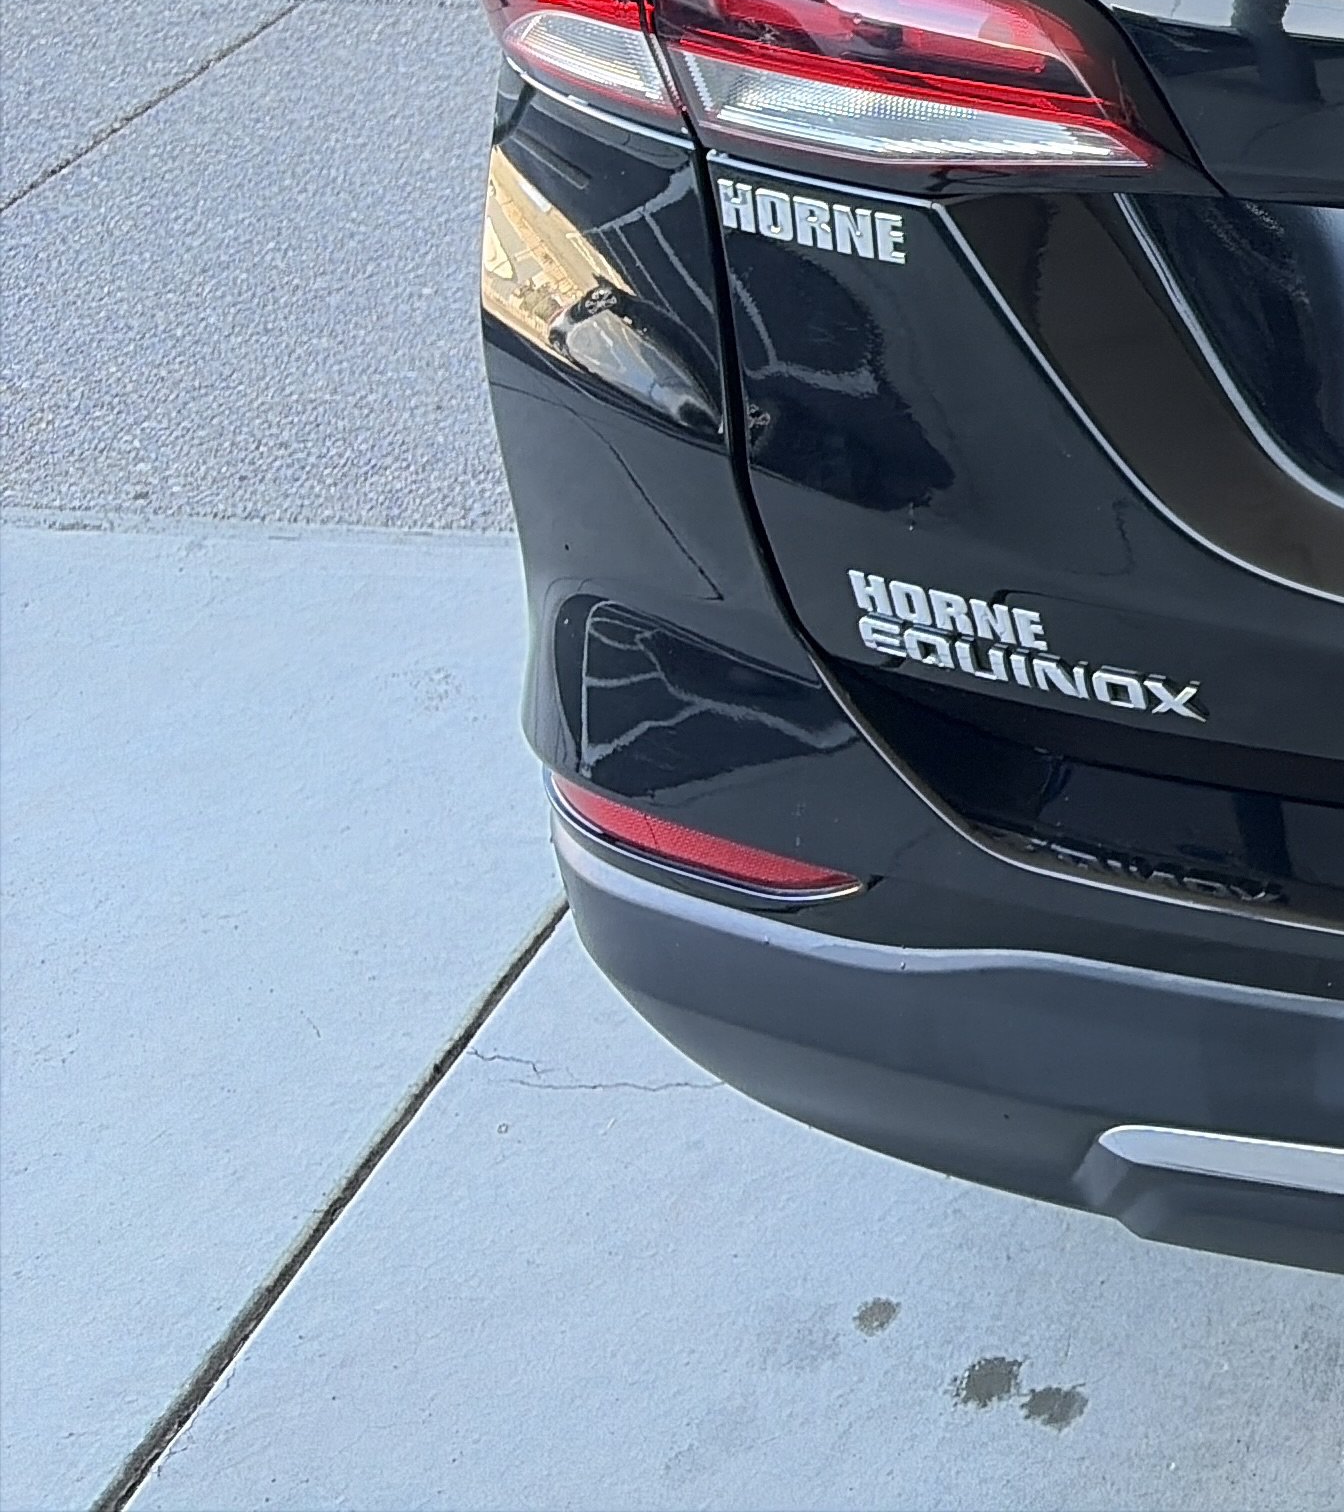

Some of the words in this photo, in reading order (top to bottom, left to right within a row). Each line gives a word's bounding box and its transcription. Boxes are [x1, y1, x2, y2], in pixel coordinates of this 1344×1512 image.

[716, 177, 906, 264] HORNE
[847, 568, 1049, 651] HORNE
[858, 614, 1209, 723] EQUINOX
